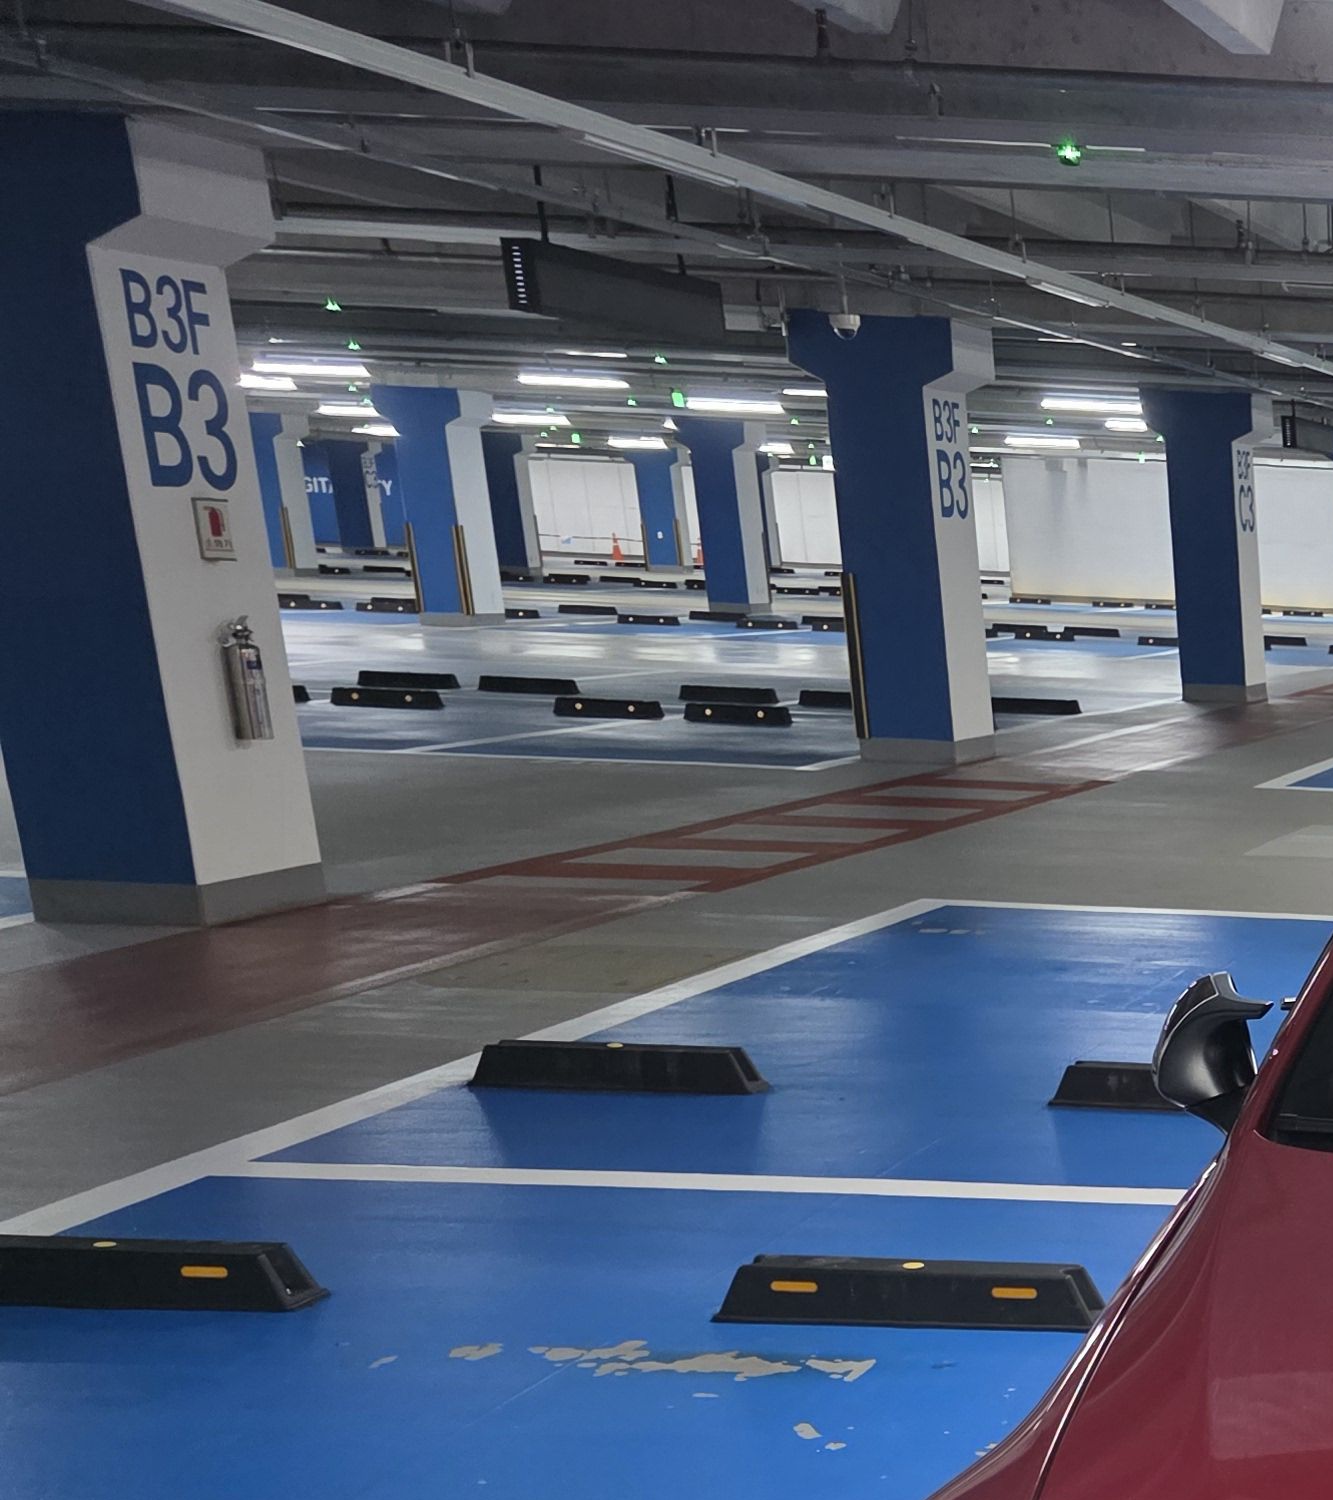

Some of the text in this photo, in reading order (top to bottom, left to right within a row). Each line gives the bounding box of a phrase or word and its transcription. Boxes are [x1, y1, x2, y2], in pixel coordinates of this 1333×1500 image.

[118, 267, 211, 356] B3F
[131, 361, 238, 491] B3
[932, 398, 961, 444] B3F
[936, 448, 969, 520] B3
